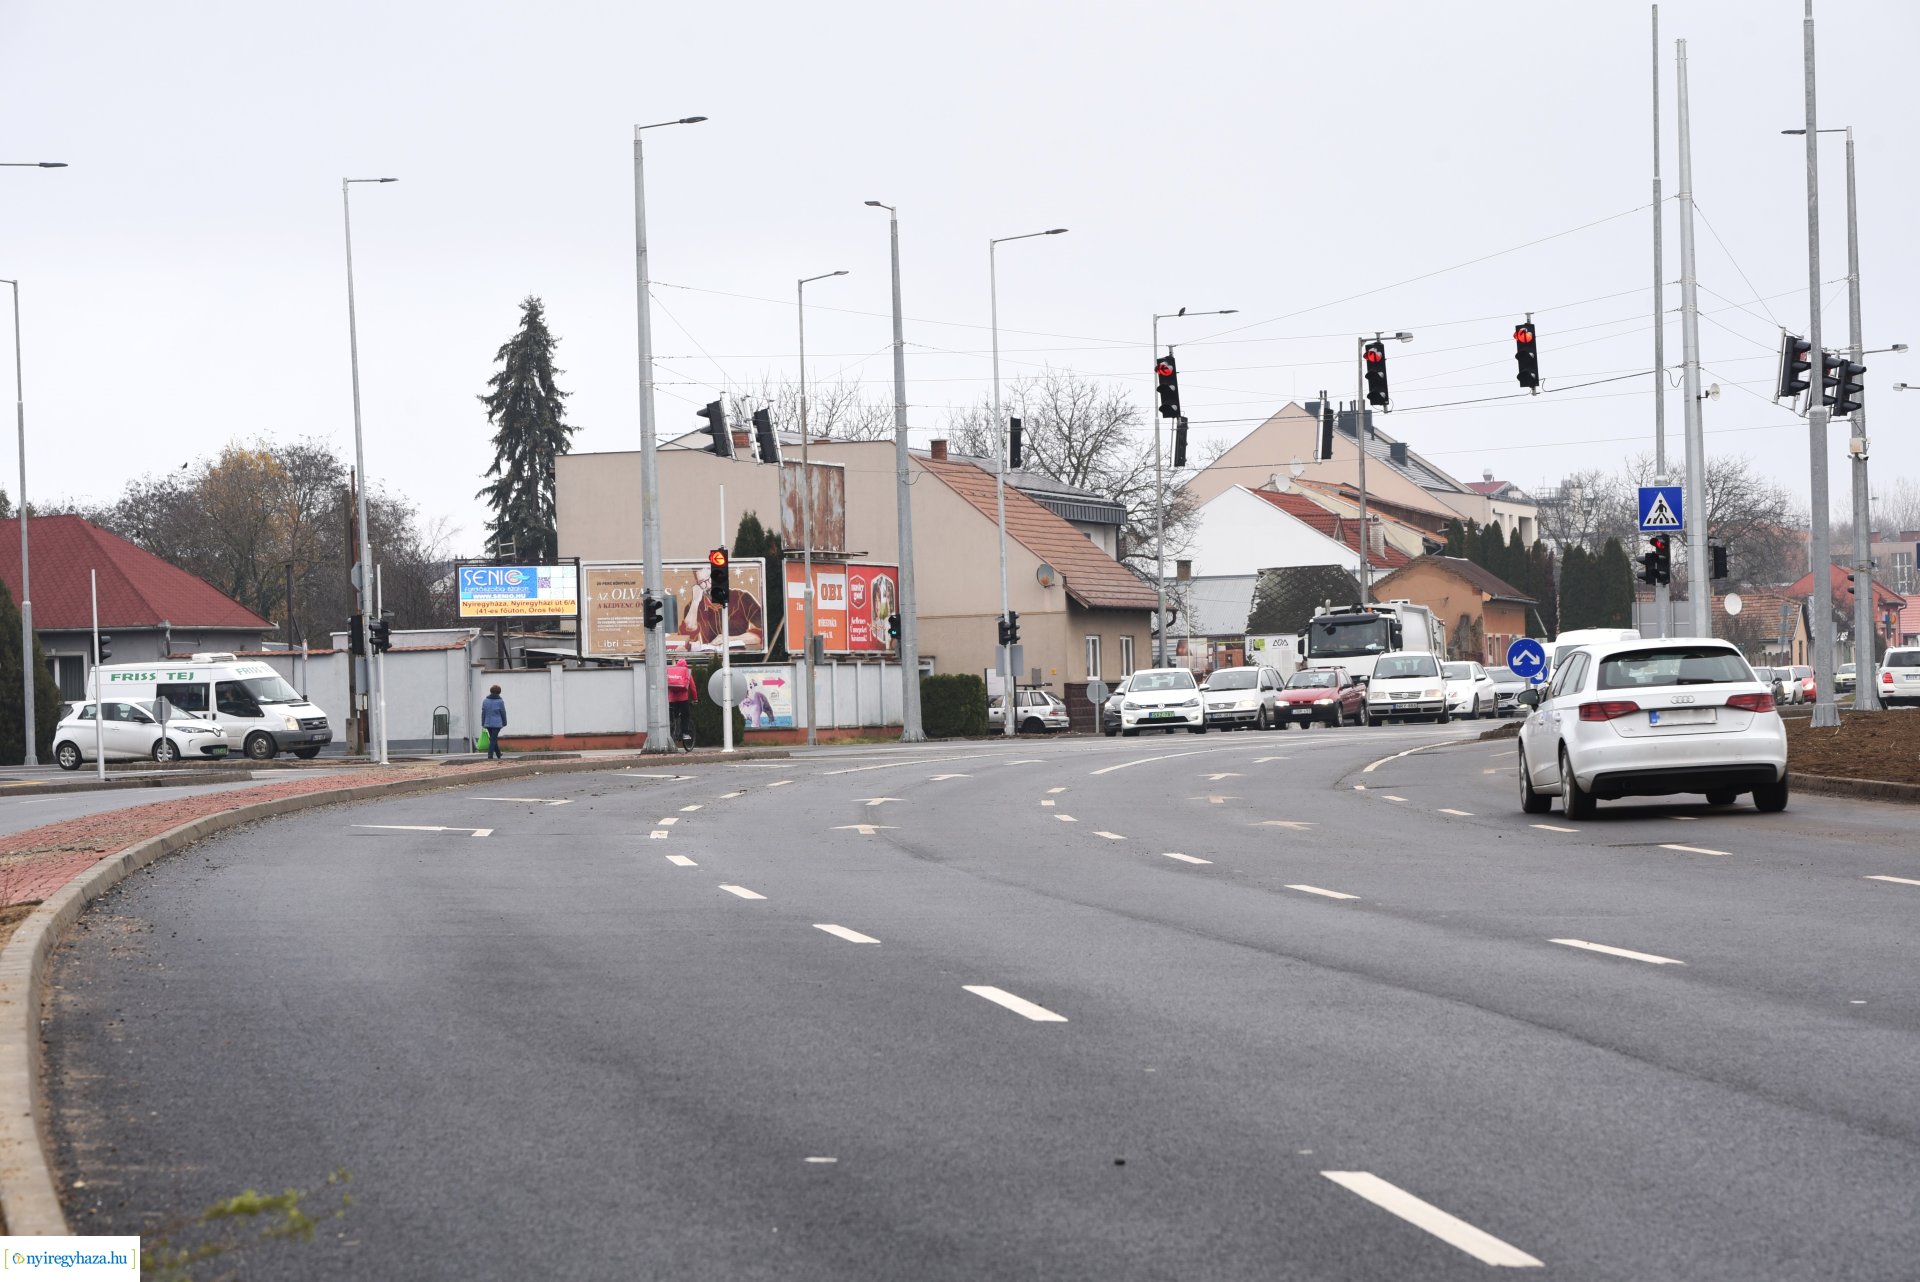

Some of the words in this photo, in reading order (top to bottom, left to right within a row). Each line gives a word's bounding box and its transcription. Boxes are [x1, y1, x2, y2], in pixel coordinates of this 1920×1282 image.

[464, 569, 526, 586] SENIO
[821, 584, 843, 600] OBI
[111, 672, 156, 682] FRISS
[166, 671, 194, 681] TEJ
